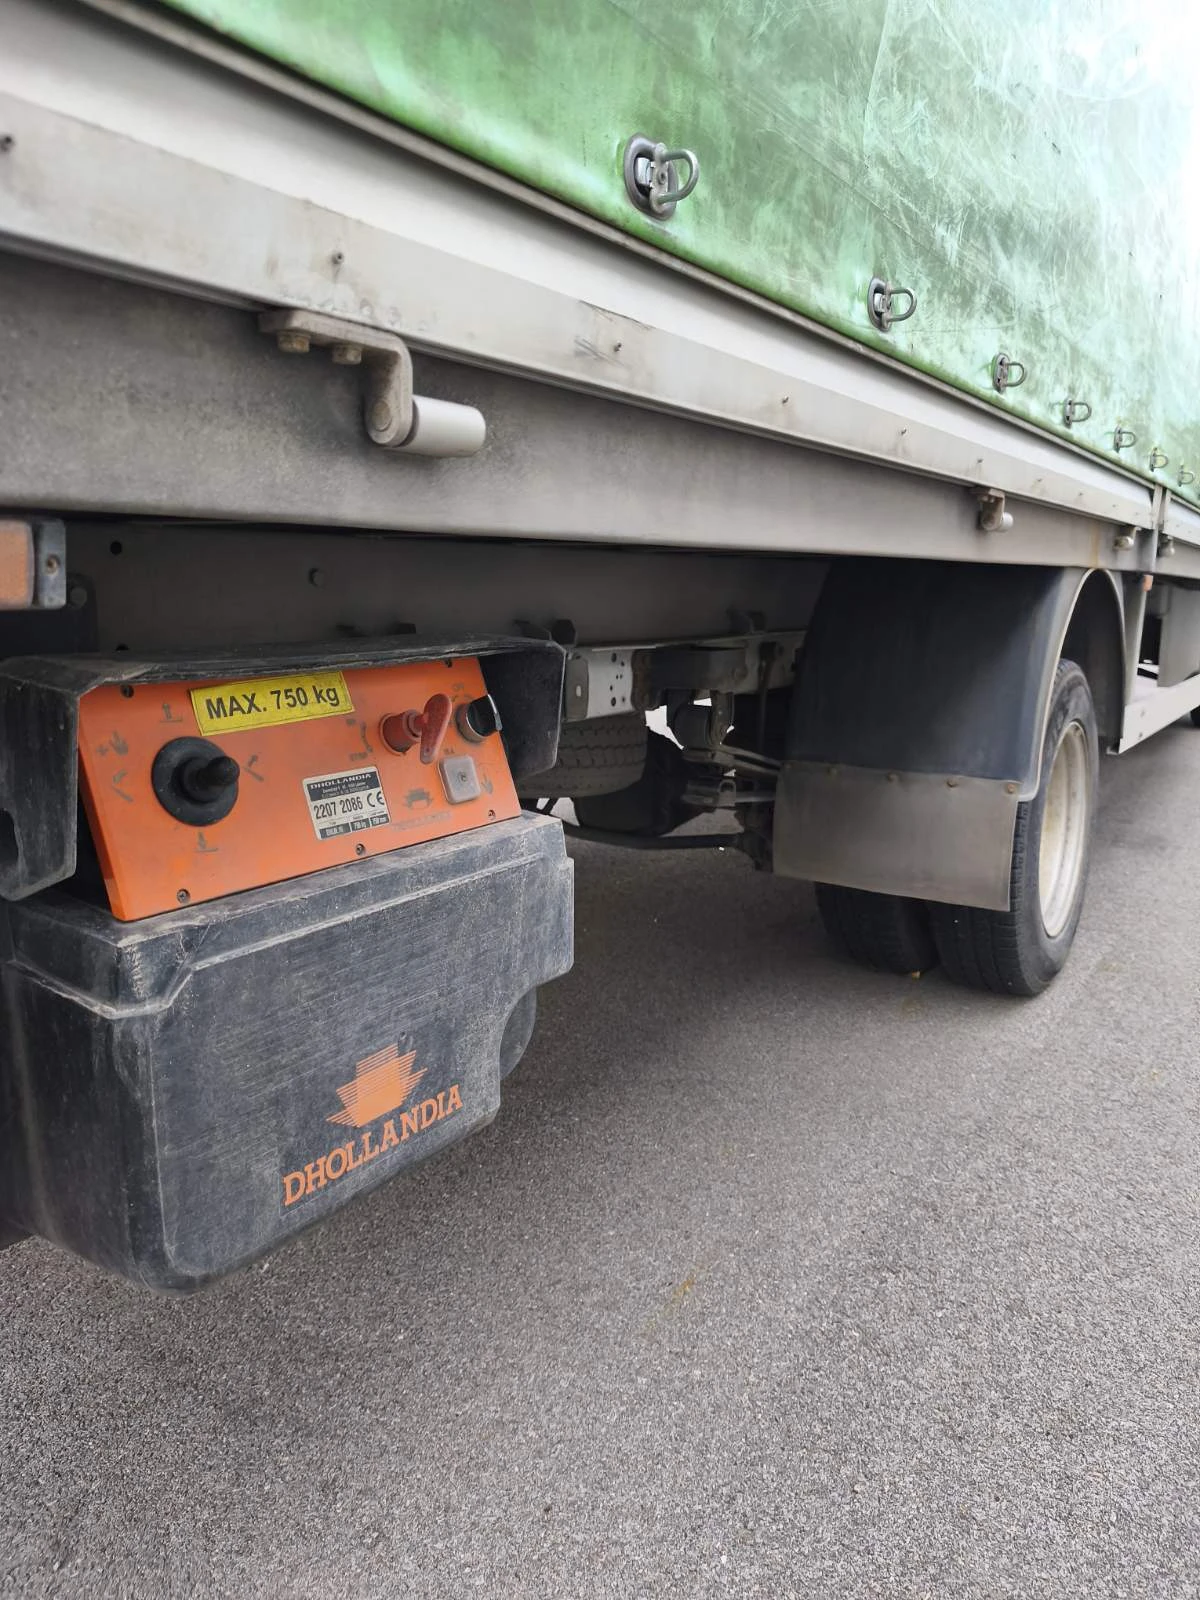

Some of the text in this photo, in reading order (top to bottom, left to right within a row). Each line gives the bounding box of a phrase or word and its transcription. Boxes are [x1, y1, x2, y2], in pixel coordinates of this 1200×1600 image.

[205, 685, 340, 720] MAX. 750 kg
[310, 773, 372, 789] DHOLLANDIA
[313, 802, 337, 820] 2207
[339, 796, 364, 814] 2086
[283, 1084, 463, 1206] DHOLLANDIA
